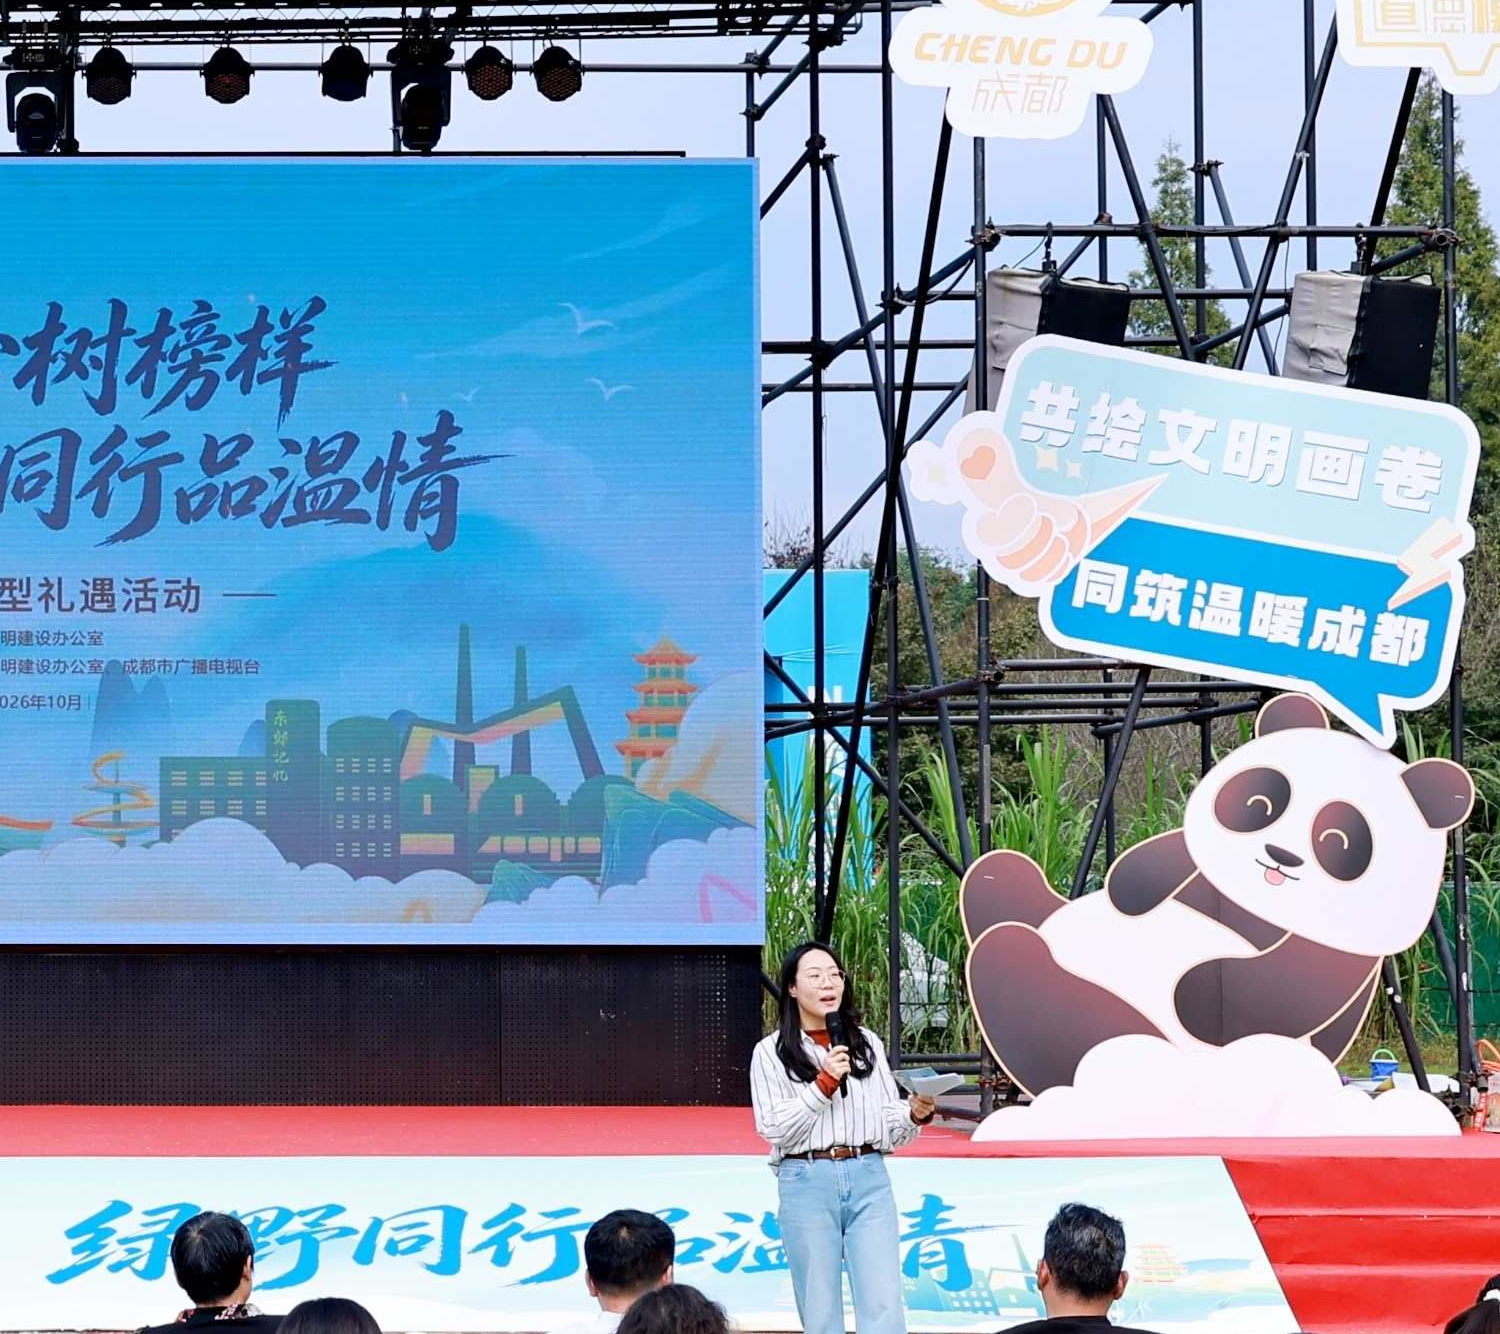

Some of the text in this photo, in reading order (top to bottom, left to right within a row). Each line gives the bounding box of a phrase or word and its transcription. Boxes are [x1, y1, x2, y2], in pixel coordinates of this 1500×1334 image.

[914, 32, 1128, 69] CHENG DU
[970, 71, 1069, 116] 成都
[1018, 379, 1445, 514] 共绘文明画卷
[1071, 557, 1431, 667] 同筑温暖成都
